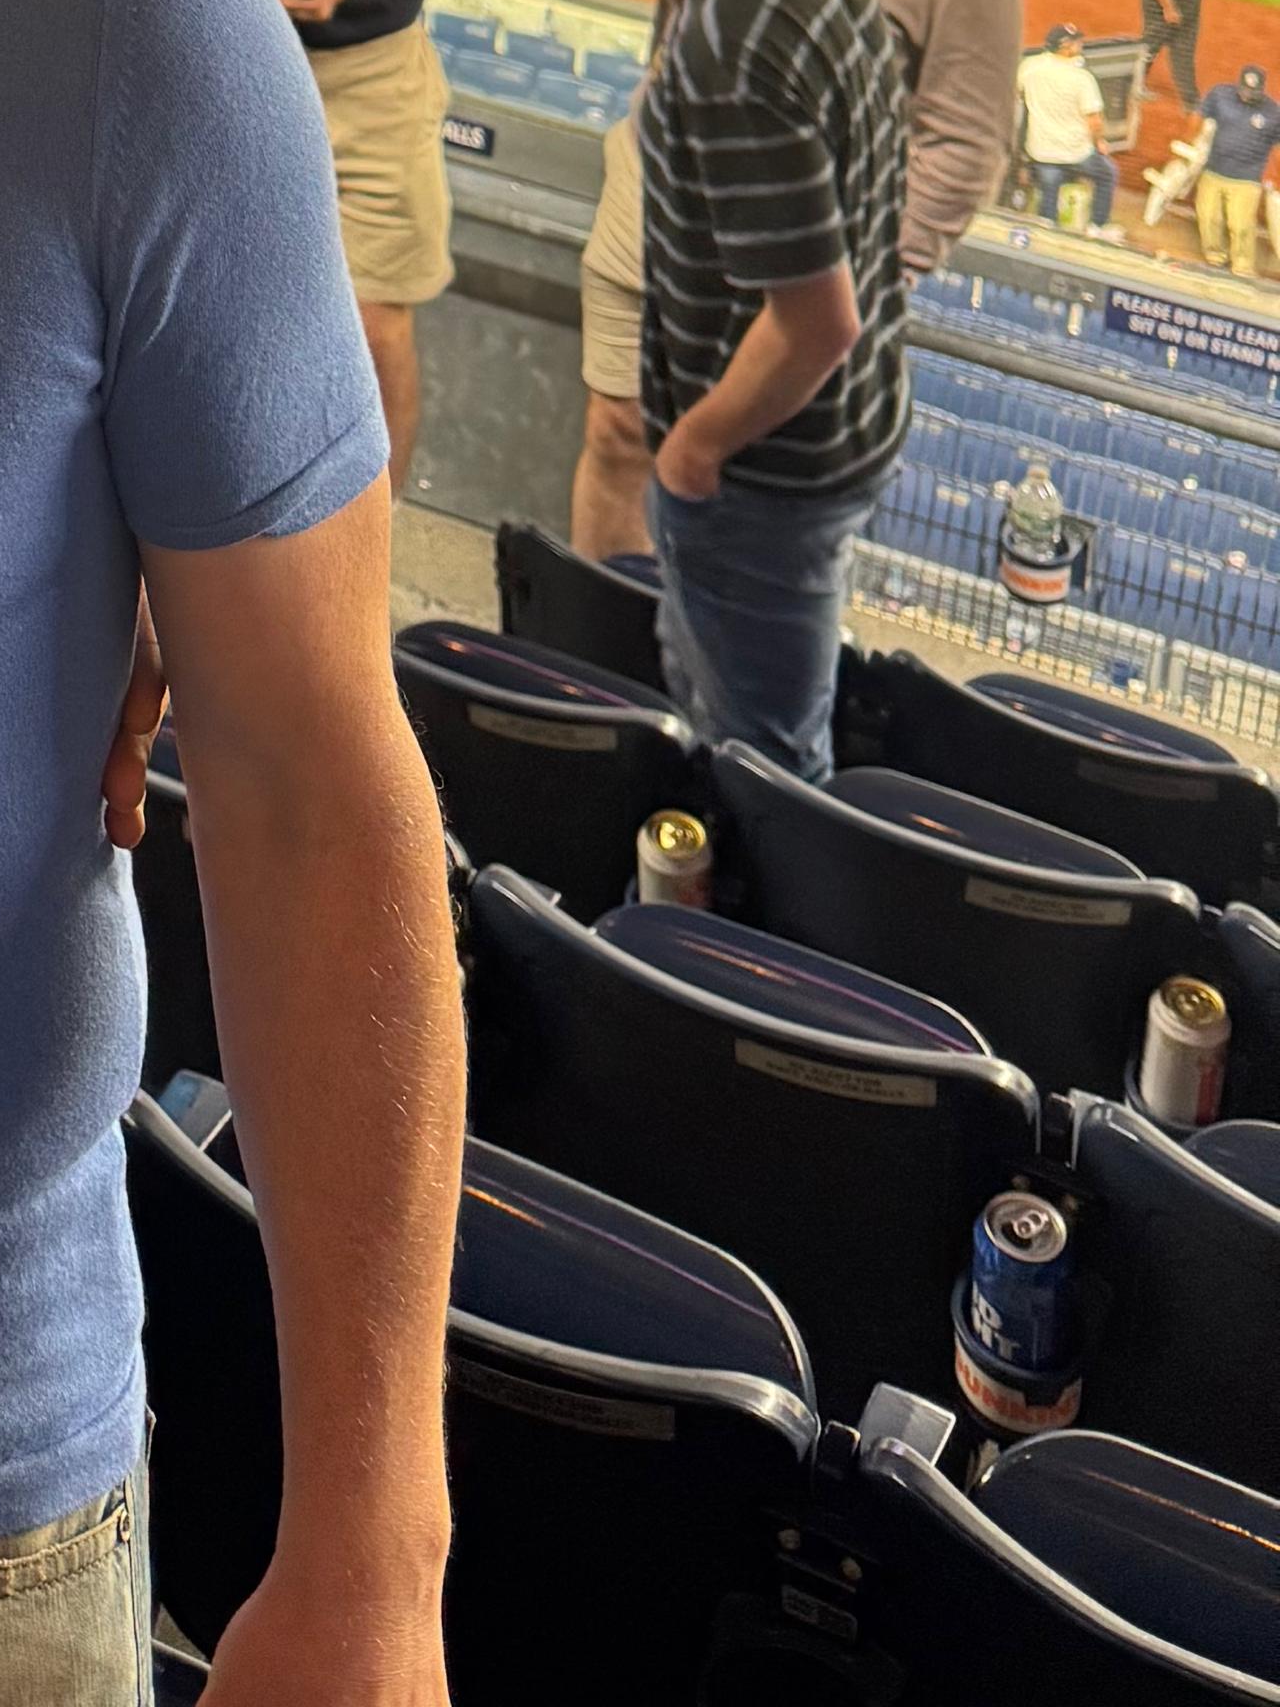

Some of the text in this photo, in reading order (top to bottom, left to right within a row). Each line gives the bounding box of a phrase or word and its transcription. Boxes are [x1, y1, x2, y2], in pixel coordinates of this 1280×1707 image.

[1111, 289, 1280, 353] PLEASE DO NOT LEAN
[1128, 313, 1156, 337] SIT
[1157, 321, 1185, 345] ON
[1209, 336, 1266, 368] STAND
[972, 1279, 1003, 1331] D
